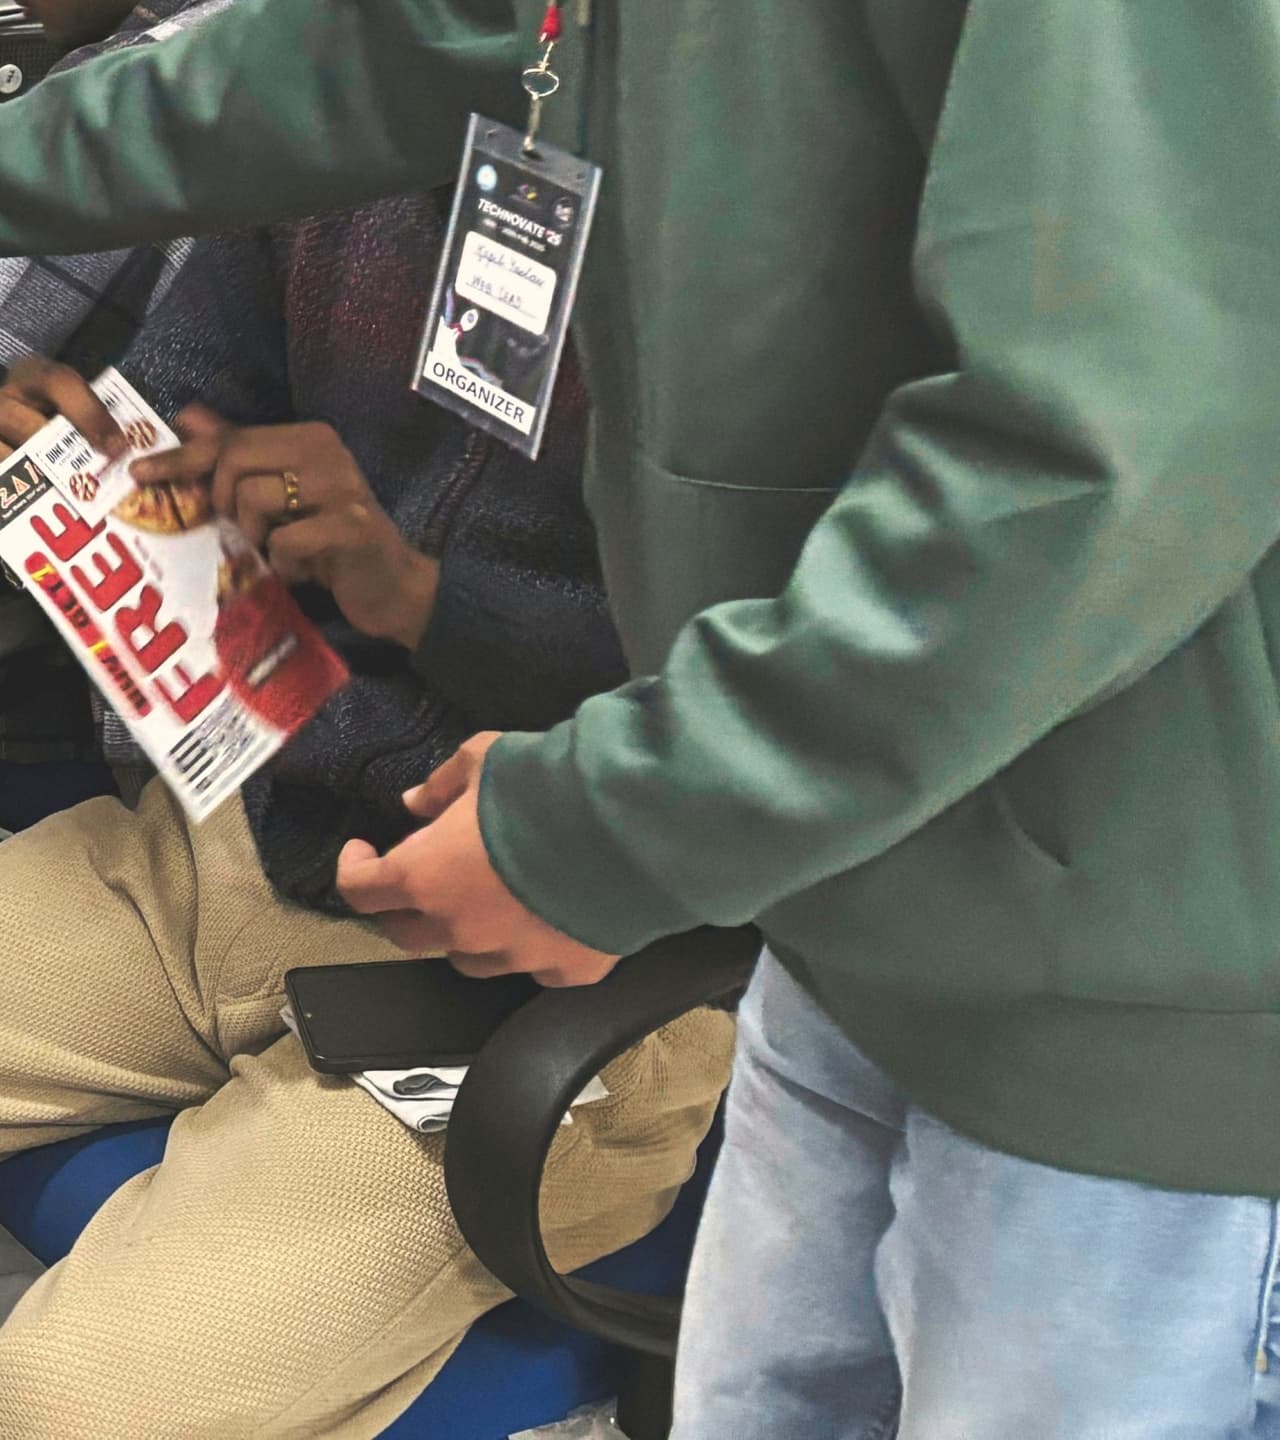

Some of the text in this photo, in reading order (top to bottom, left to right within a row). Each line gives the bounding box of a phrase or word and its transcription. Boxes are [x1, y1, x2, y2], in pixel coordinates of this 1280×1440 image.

[477, 197, 545, 239] TECHNOVATE
[432, 362, 525, 424] ORGANIZER
[29, 502, 227, 724] FREE
